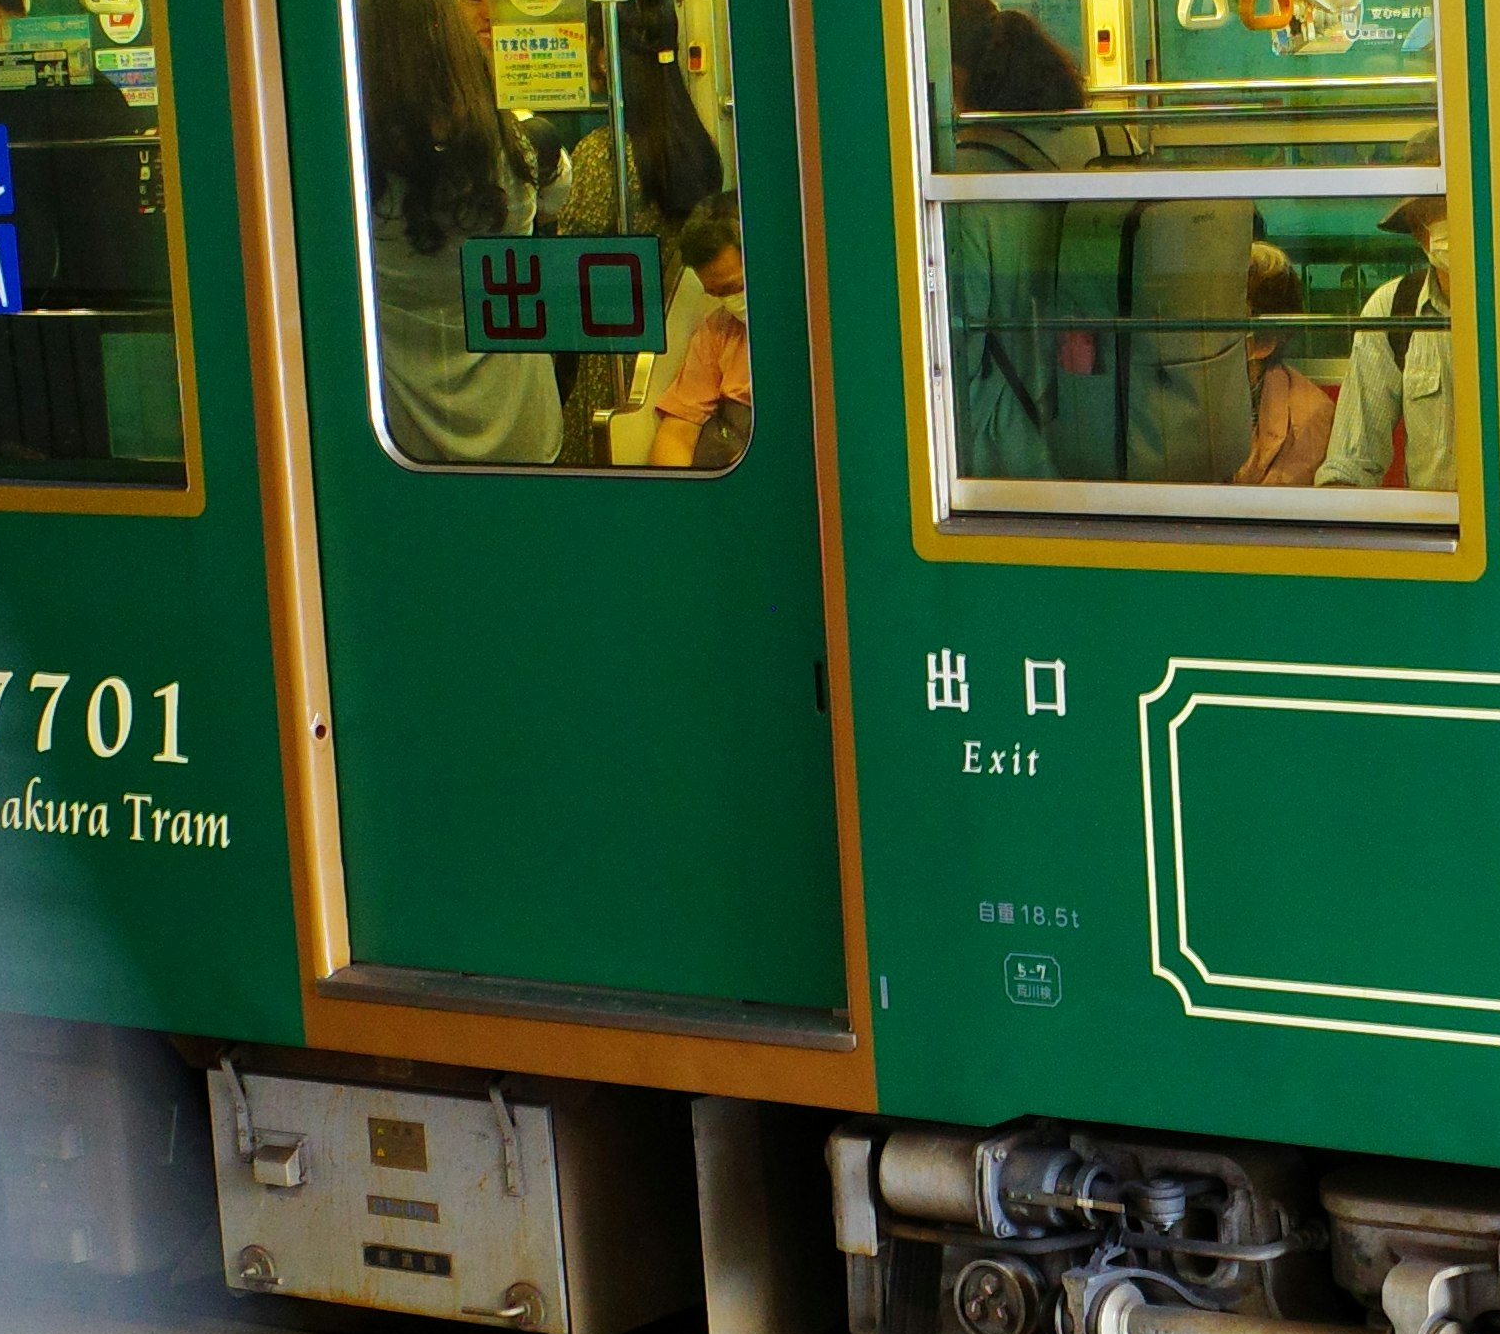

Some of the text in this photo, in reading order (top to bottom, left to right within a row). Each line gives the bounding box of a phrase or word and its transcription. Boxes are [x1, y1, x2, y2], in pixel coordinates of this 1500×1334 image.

[481, 248, 645, 340] 出口
[925, 647, 1067, 717] 出口
[961, 739, 1040, 778] Exit
[122, 792, 231, 849] Tram
[978, 900, 1015, 925] 自重
[1016, 962, 1047, 981] 5-7
[1016, 983, 1052, 1002] 荒川検
